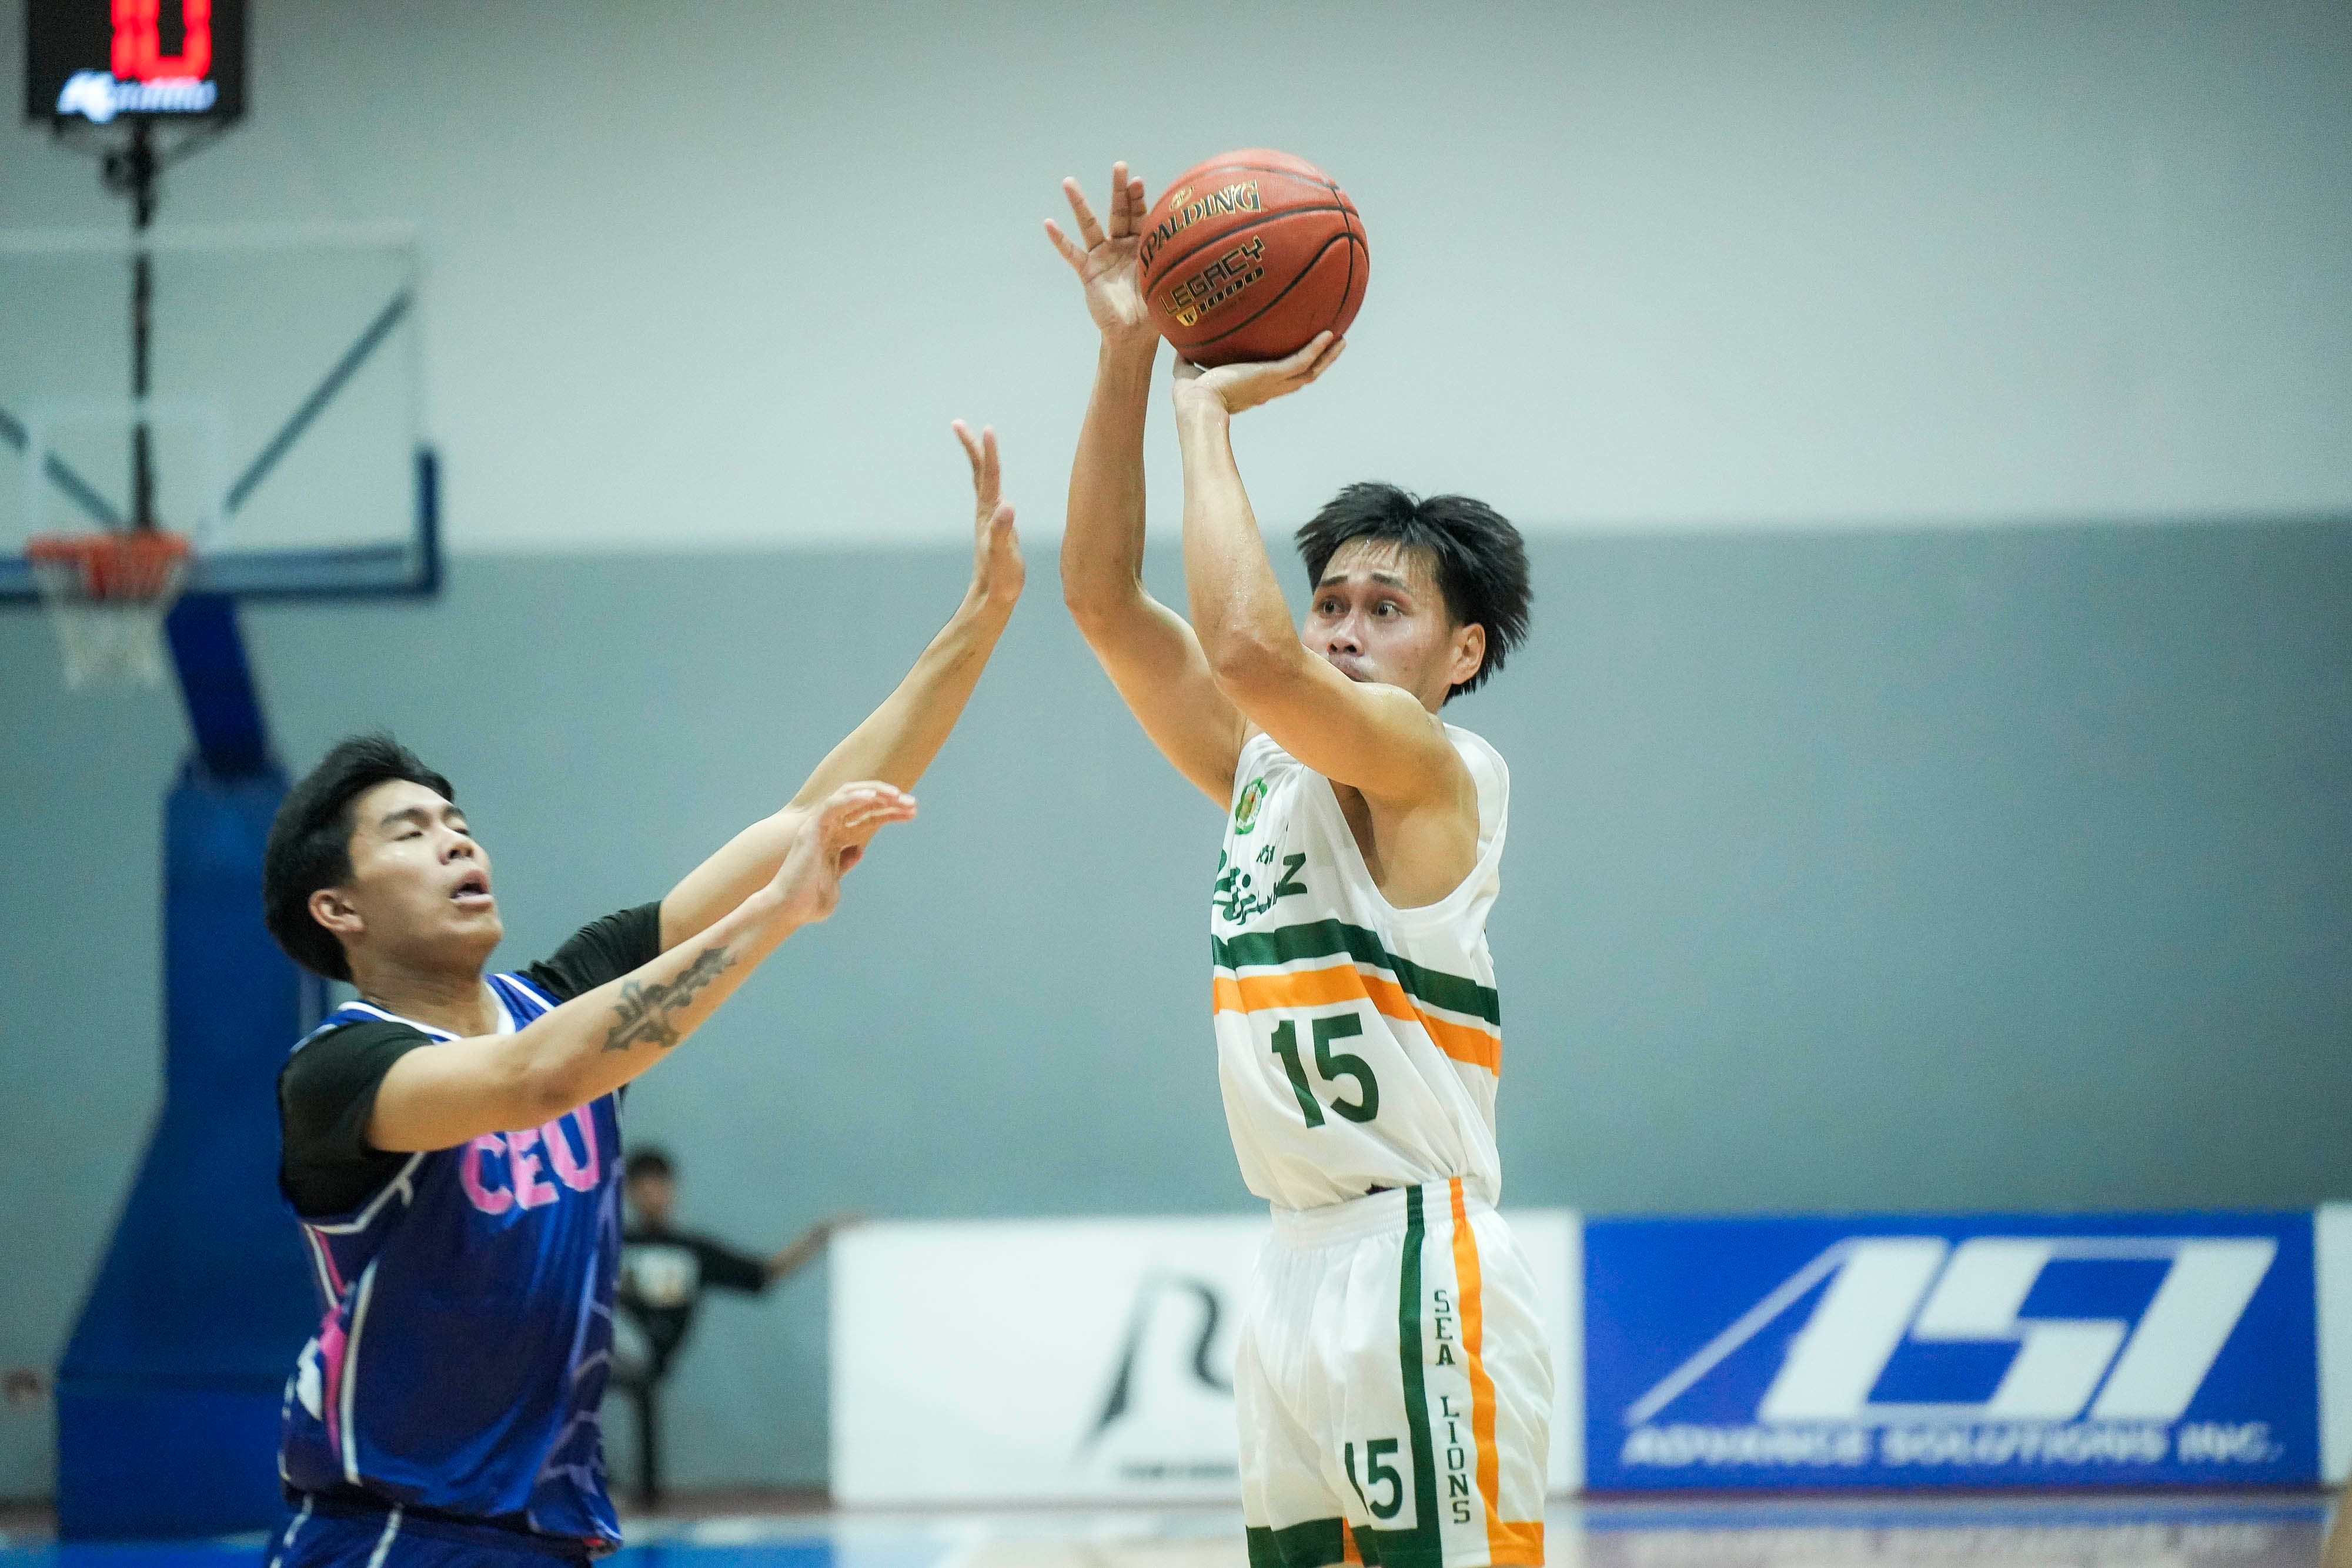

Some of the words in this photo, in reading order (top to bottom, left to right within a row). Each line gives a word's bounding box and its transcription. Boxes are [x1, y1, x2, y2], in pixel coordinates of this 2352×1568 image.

[1140, 179, 1261, 278] SPALDING
[1158, 235, 1265, 317] LEGACY
[1271, 1012, 1379, 1129] 15
[460, 1104, 600, 1215] CEU
[1434, 1289, 1456, 1366] SEA
[1440, 1395, 1471, 1524] LIONS
[1882, 1422, 2171, 1465] SOLUTIONS
